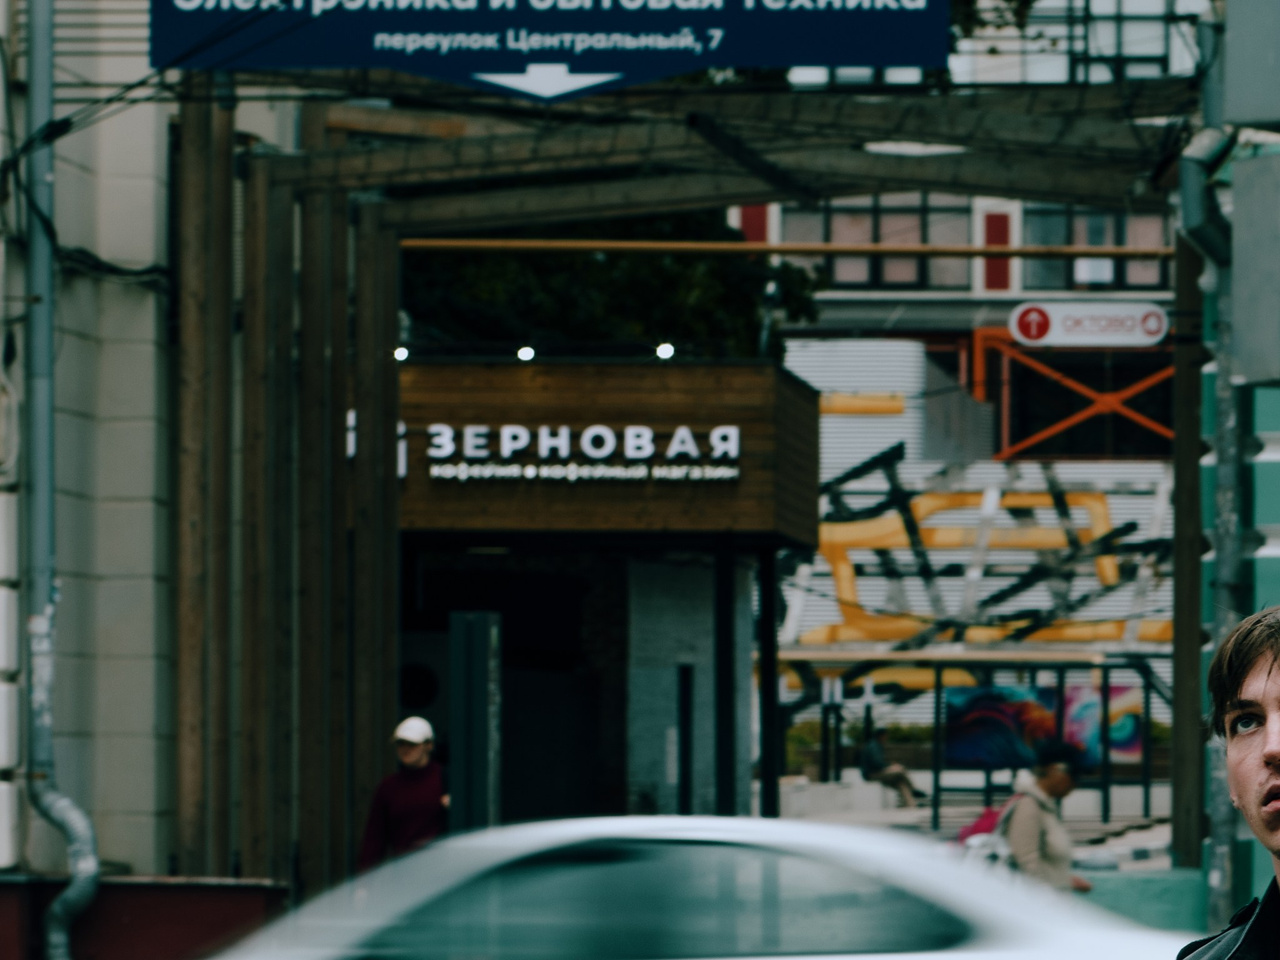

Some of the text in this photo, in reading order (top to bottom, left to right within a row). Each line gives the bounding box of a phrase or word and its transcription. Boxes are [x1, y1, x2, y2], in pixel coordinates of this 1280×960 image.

[373, 27, 723, 54] переулок Центральный, 7
[426, 424, 740, 460] ЗЕРНОВАЯ
[430, 462, 523, 482] кофейня
[539, 462, 648, 482] кофейный
